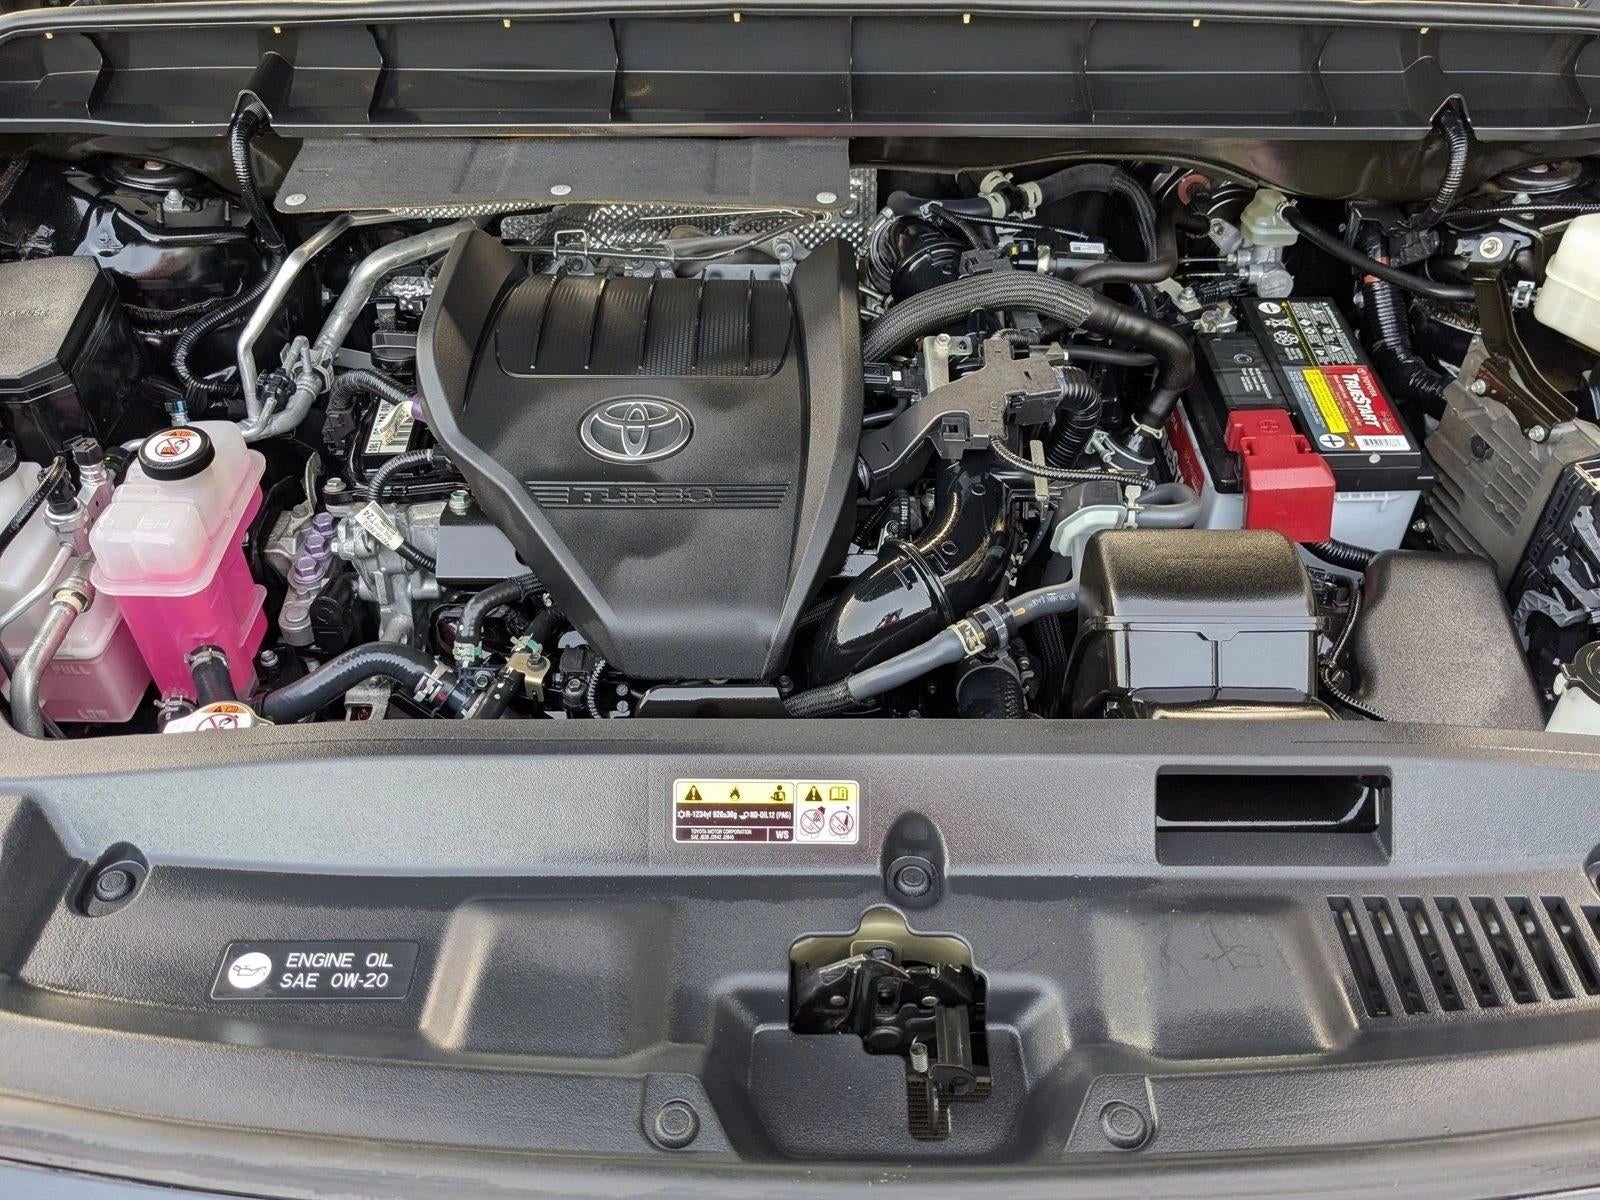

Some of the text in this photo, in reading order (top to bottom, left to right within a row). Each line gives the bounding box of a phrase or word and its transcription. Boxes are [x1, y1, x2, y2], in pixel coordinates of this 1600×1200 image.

[1361, 374, 1378, 397] TOYOTA
[573, 486, 712, 504] TURBO
[775, 830, 789, 839] WS
[286, 952, 394, 968] ENGINE OIL
[279, 972, 389, 988] SAE 0W-20
